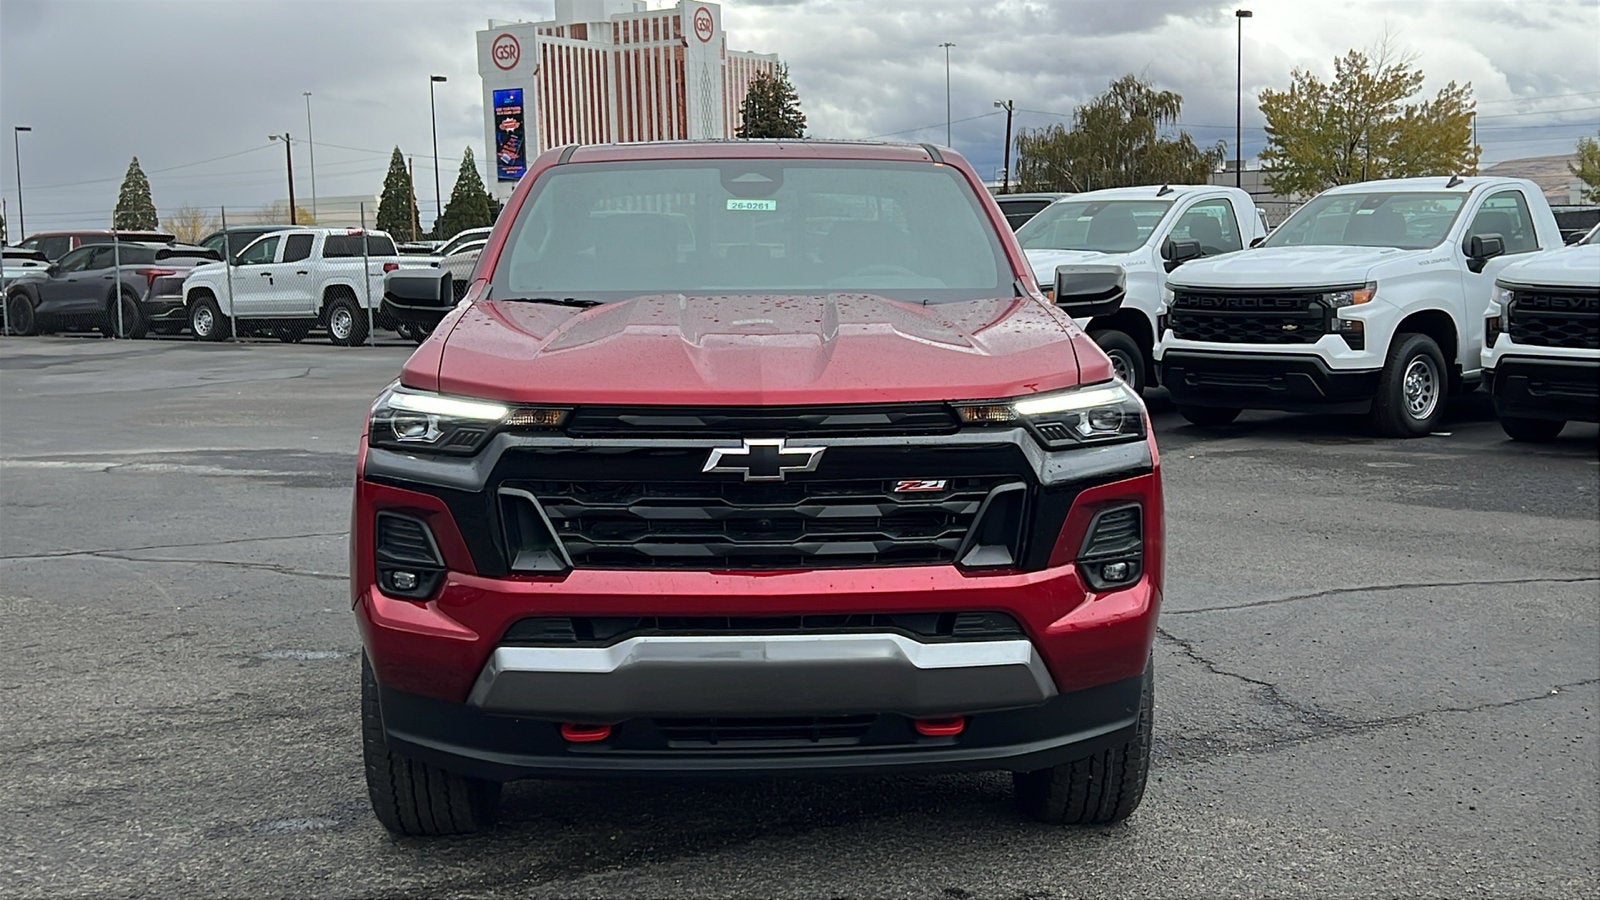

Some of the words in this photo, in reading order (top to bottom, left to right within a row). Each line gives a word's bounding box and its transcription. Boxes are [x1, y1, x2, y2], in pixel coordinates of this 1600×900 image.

[697, 17, 711, 32] GSR
[495, 44, 516, 60] GSR
[1177, 295, 1309, 307] CHEVROLET
[894, 480, 946, 492] Z71
